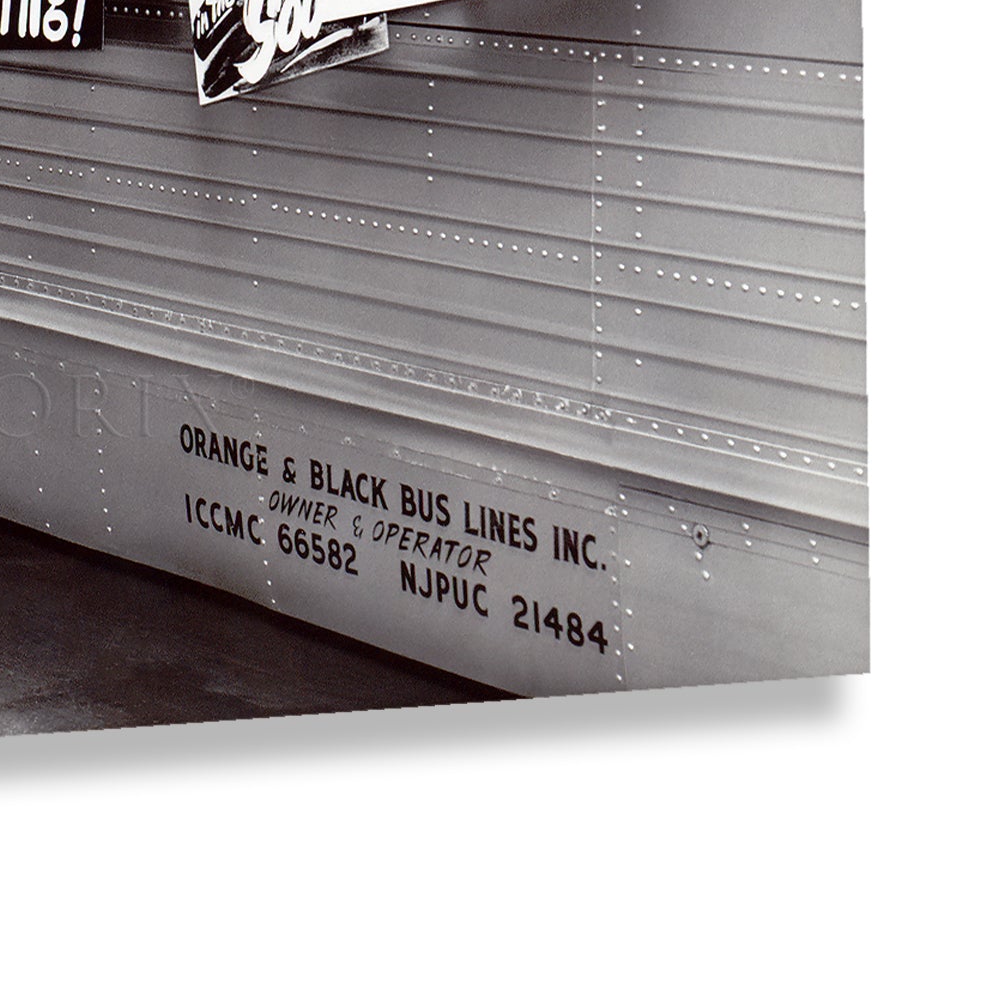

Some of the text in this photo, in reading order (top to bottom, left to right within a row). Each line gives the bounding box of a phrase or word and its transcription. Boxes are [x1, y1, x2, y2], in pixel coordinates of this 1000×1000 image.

[179, 423, 607, 571] ORANGE & BLACK BUS LINES INC.
[268, 490, 492, 575] OWNER & OPERATOR
[184, 493, 608, 655] ICCMC 66582 NJPUC 21484
